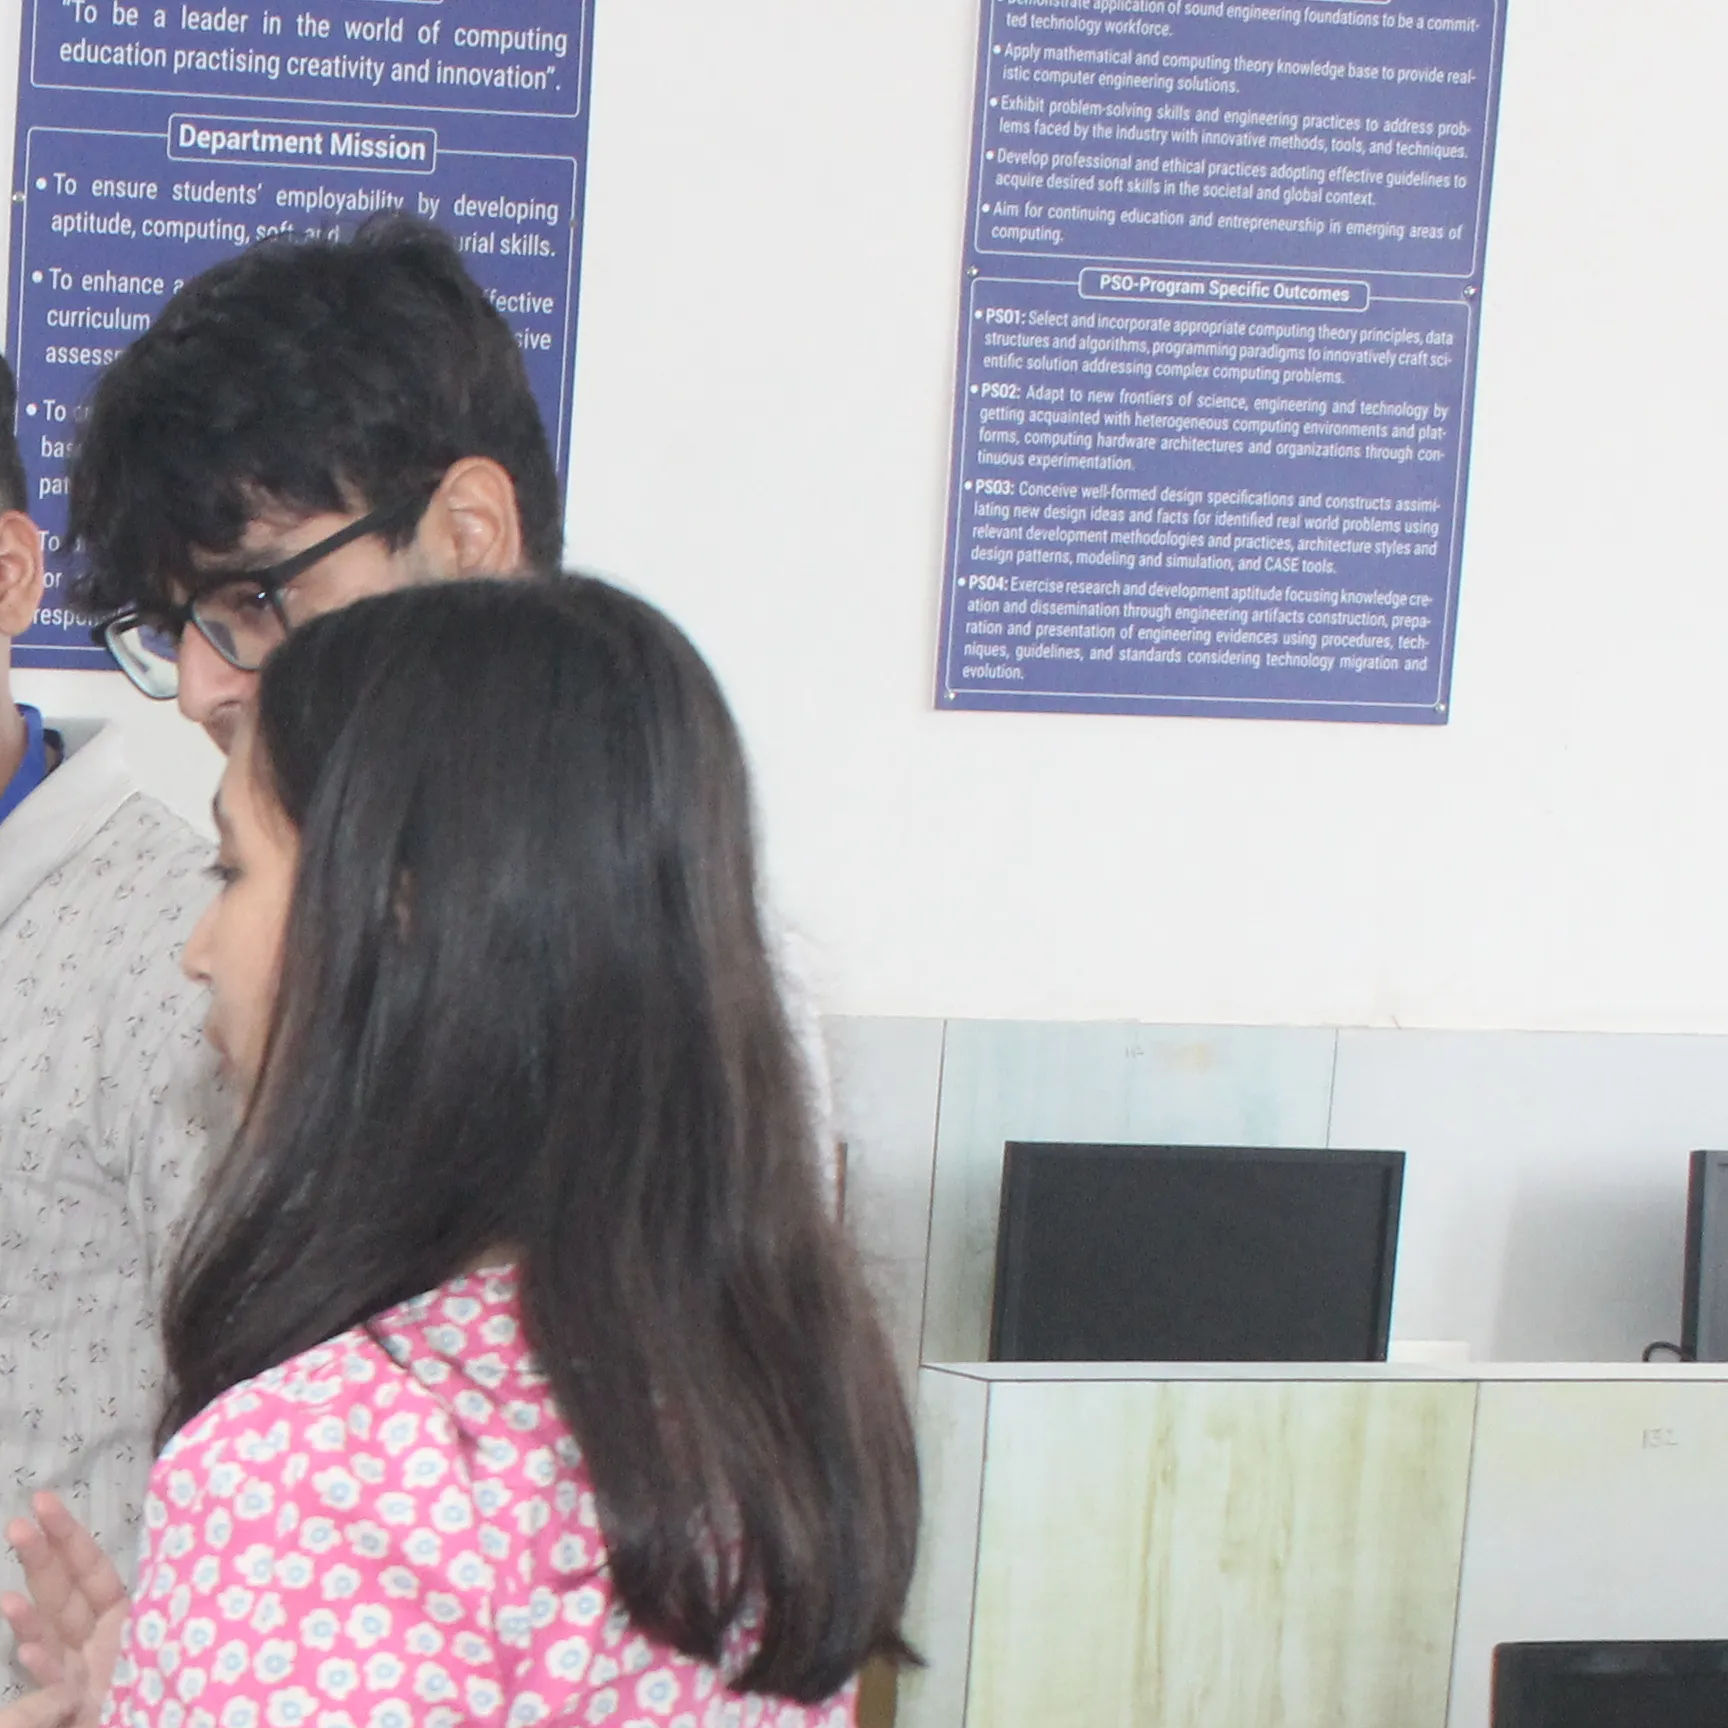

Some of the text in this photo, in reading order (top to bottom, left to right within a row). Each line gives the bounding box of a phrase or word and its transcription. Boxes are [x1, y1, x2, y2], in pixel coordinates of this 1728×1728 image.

[112, 0, 139, 25] be
[153, 8, 166, 26] a
[181, 5, 248, 31] leader
[262, 11, 281, 33] in
[296, 13, 330, 36] the
[344, 16, 403, 40] world
[417, 21, 439, 42] of
[453, 23, 566, 55] computing
[59, 39, 167, 68] education
[173, 46, 280, 78] practising
[286, 54, 384, 85] creativity
[390, 60, 429, 83] and
[1043, 44, 1132, 64] mathematical
[1097, 71, 1174, 93] engineering
[1177, 74, 1240, 93] solutions.
[178, 124, 426, 161] Department Mission
[1201, 129, 1267, 147] innovative
[1395, 139, 1468, 161] techniques.
[1051, 150, 1132, 172] professional
[1385, 169, 1451, 190] guidelines
[52, 175, 77, 196] To
[91, 180, 158, 201] ensure
[275, 186, 404, 215] employability
[417, 194, 440, 218] by
[453, 194, 559, 224] developing
[1047, 202, 1116, 225] continuing
[1217, 213, 1325, 235] entrepreneurship
[50, 212, 137, 239] aptitude,
[141, 218, 250, 245] computing,
[499, 234, 556, 257] skills.
[990, 223, 1064, 245] computing.
[48, 270, 72, 291] To
[81, 270, 164, 294] enhance
[1099, 273, 1350, 302] PSO-Program Specific Outcomes
[46, 307, 150, 331] curriculum
[1081, 357, 1153, 378] addressing
[43, 400, 66, 422] To
[1253, 396, 1327, 416] engineering
[1359, 399, 1429, 420] technology
[1214, 509, 1274, 527] identified
[1015, 642, 1084, 662] guidelines,
[1186, 648, 1261, 669] considering
[1265, 650, 1335, 671] technology
[962, 662, 1024, 679] evolution.
